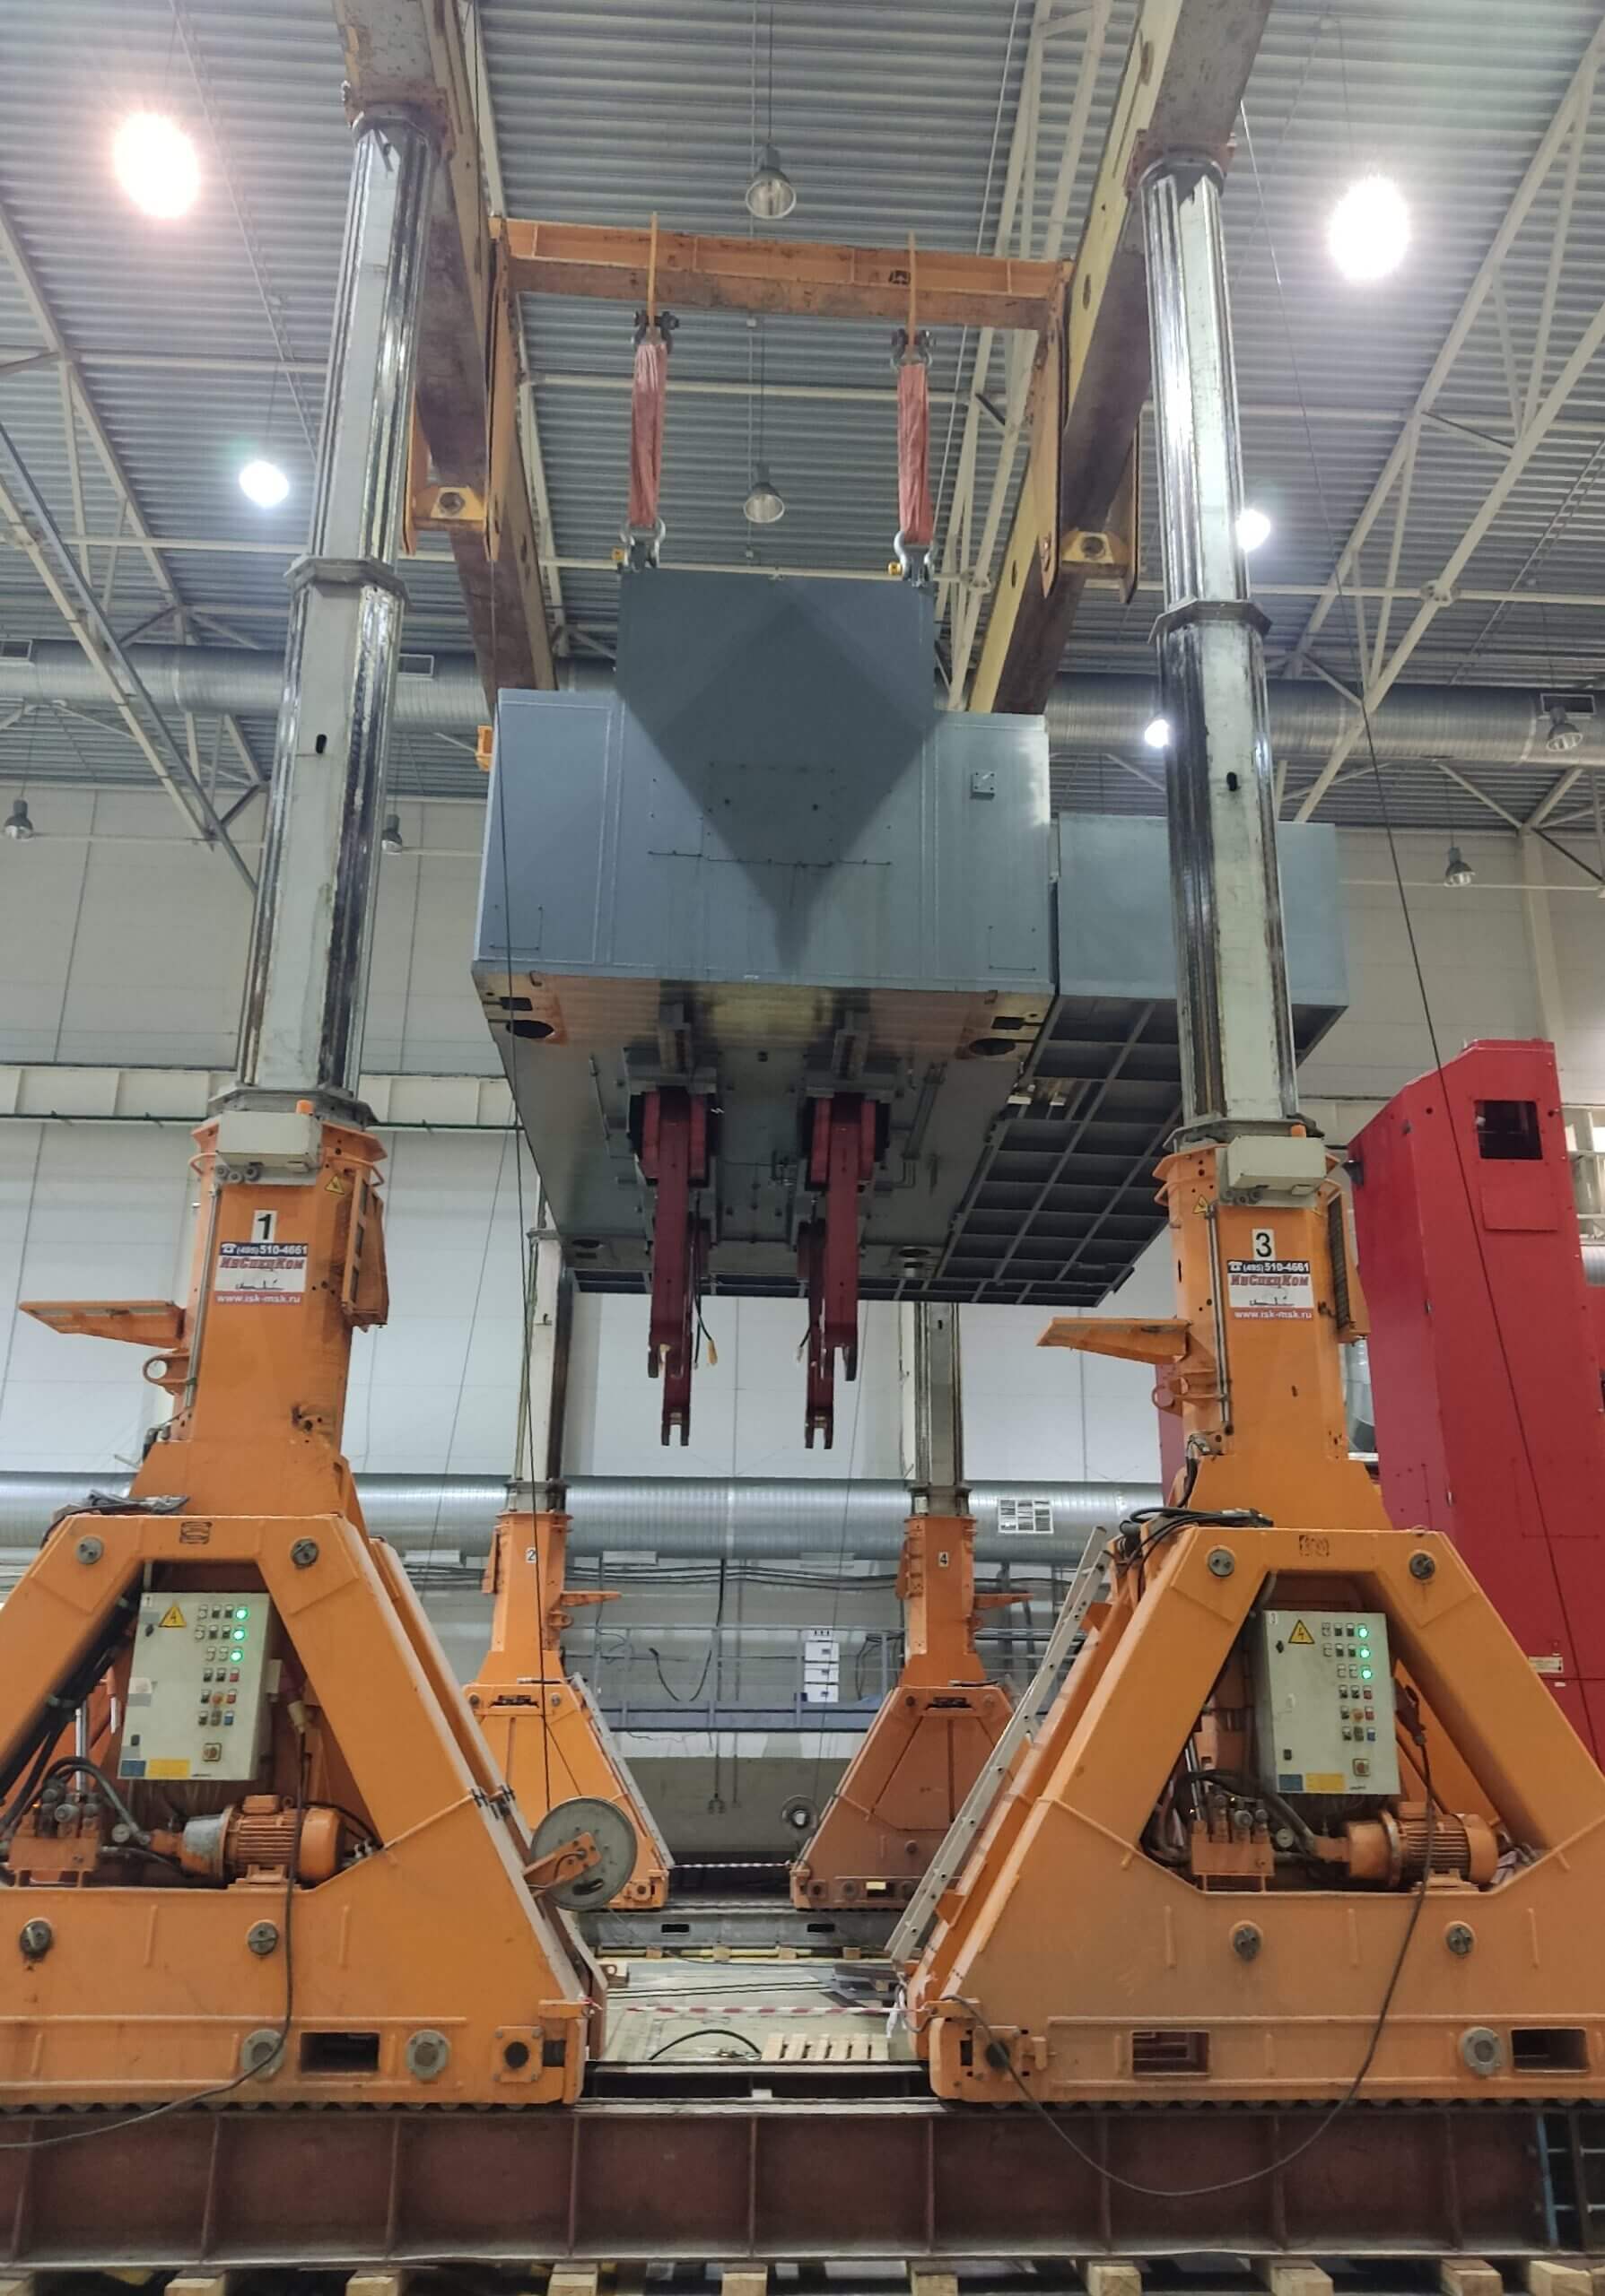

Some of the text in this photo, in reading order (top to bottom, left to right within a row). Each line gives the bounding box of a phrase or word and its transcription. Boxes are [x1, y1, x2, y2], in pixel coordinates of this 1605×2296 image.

[257, 1213, 272, 1239] 1
[259, 1244, 308, 1255] 510-4661
[1255, 1232, 1272, 1257] 3
[939, 1553, 948, 1565] 4
